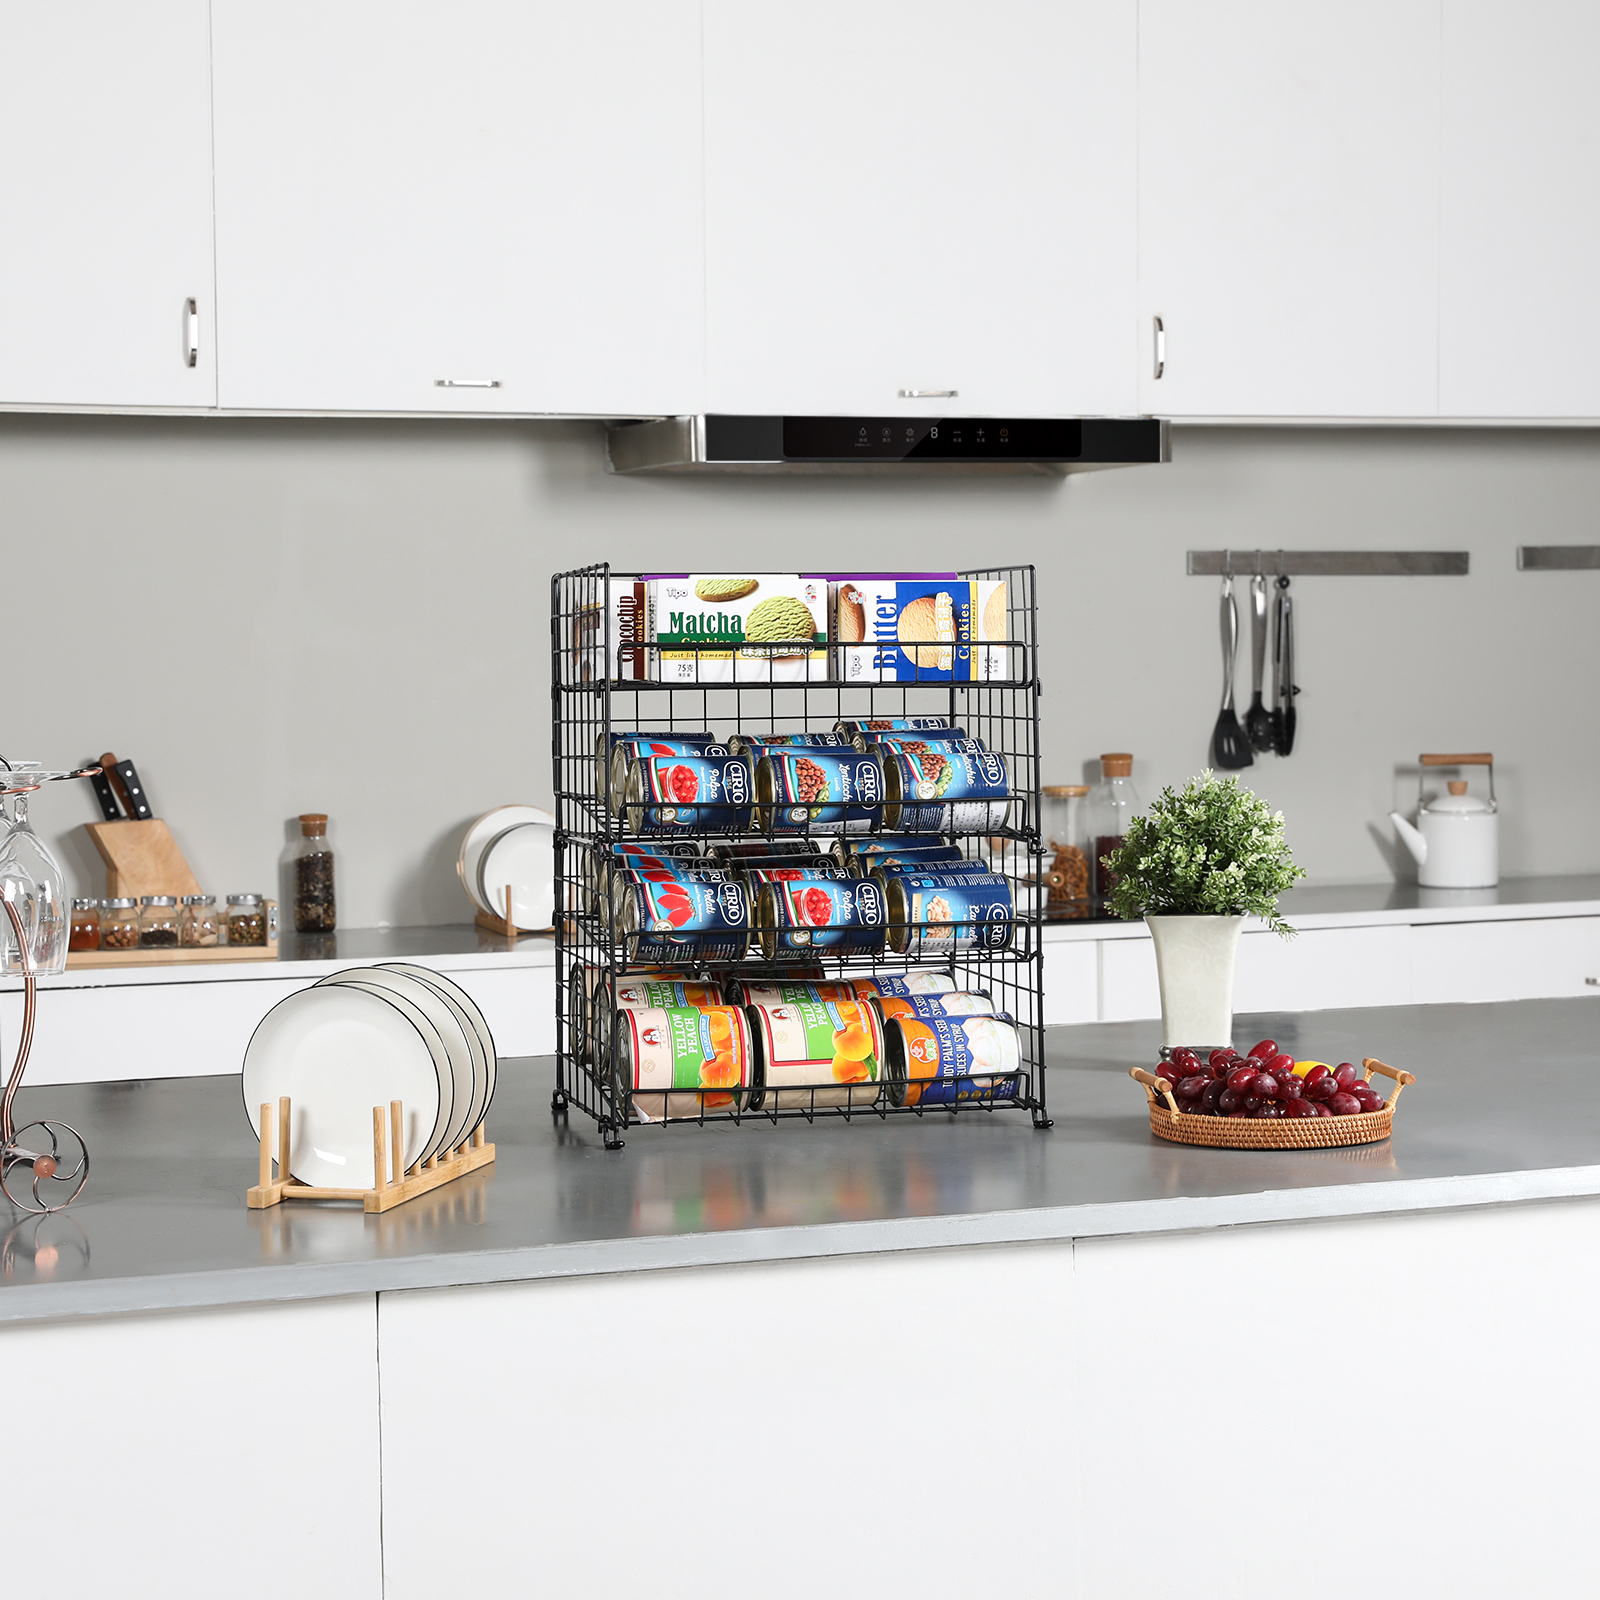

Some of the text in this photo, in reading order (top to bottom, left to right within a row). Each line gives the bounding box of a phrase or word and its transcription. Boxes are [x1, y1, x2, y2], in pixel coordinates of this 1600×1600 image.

[930, 426, 938, 439] 8
[666, 587, 689, 599] Tipo
[635, 609, 644, 650] ookies
[669, 612, 743, 634] Matcha
[873, 594, 898, 670] Butter
[851, 655, 862, 677] Tipo
[983, 753, 999, 781] IRIO
[708, 769, 721, 800] Polpa
[730, 764, 745, 804] CIRIO
[839, 763, 854, 804] Lenticch
[703, 888, 717, 915] Pelati
[724, 884, 740, 920] CIRIO
[841, 890, 854, 920] Polpa
[861, 886, 877, 925] CIRIO
[992, 908, 1004, 945] CRIO
[660, 983, 675, 1009] PEACH
[799, 1003, 818, 1030] YELLO
[672, 1013, 688, 1059] YELLOW
[684, 1017, 699, 1054] PEACH
[939, 1033, 954, 1061] PALM'S
[950, 1023, 967, 1076] SLICES IN SYRUP
